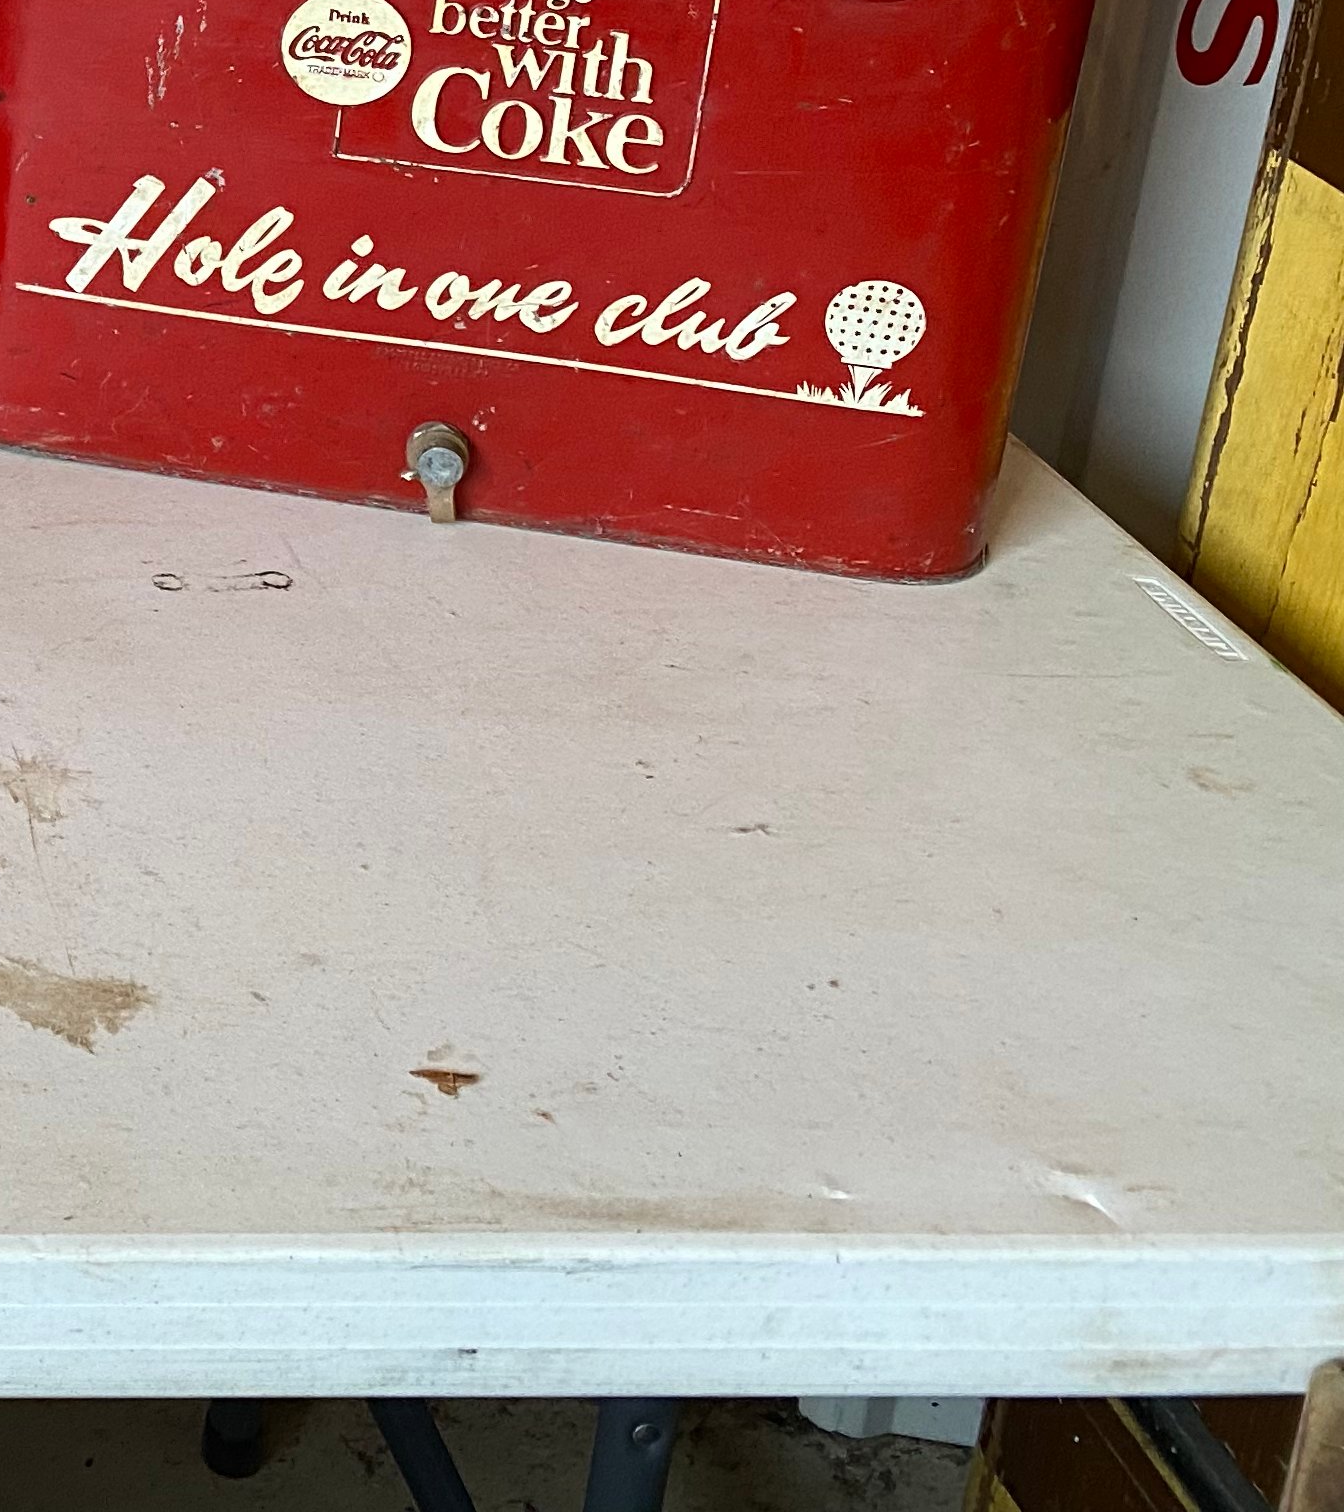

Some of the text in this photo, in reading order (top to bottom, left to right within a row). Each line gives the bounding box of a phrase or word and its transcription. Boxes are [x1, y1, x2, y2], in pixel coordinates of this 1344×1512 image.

[288, 25, 406, 71] Coca-Cola
[329, 8, 371, 26] Drink
[490, 30, 655, 106] with
[410, 64, 665, 176] Coke
[48, 172, 306, 316] Hole
[321, 233, 420, 312] in
[424, 270, 580, 335] one
[593, 275, 799, 363] club
